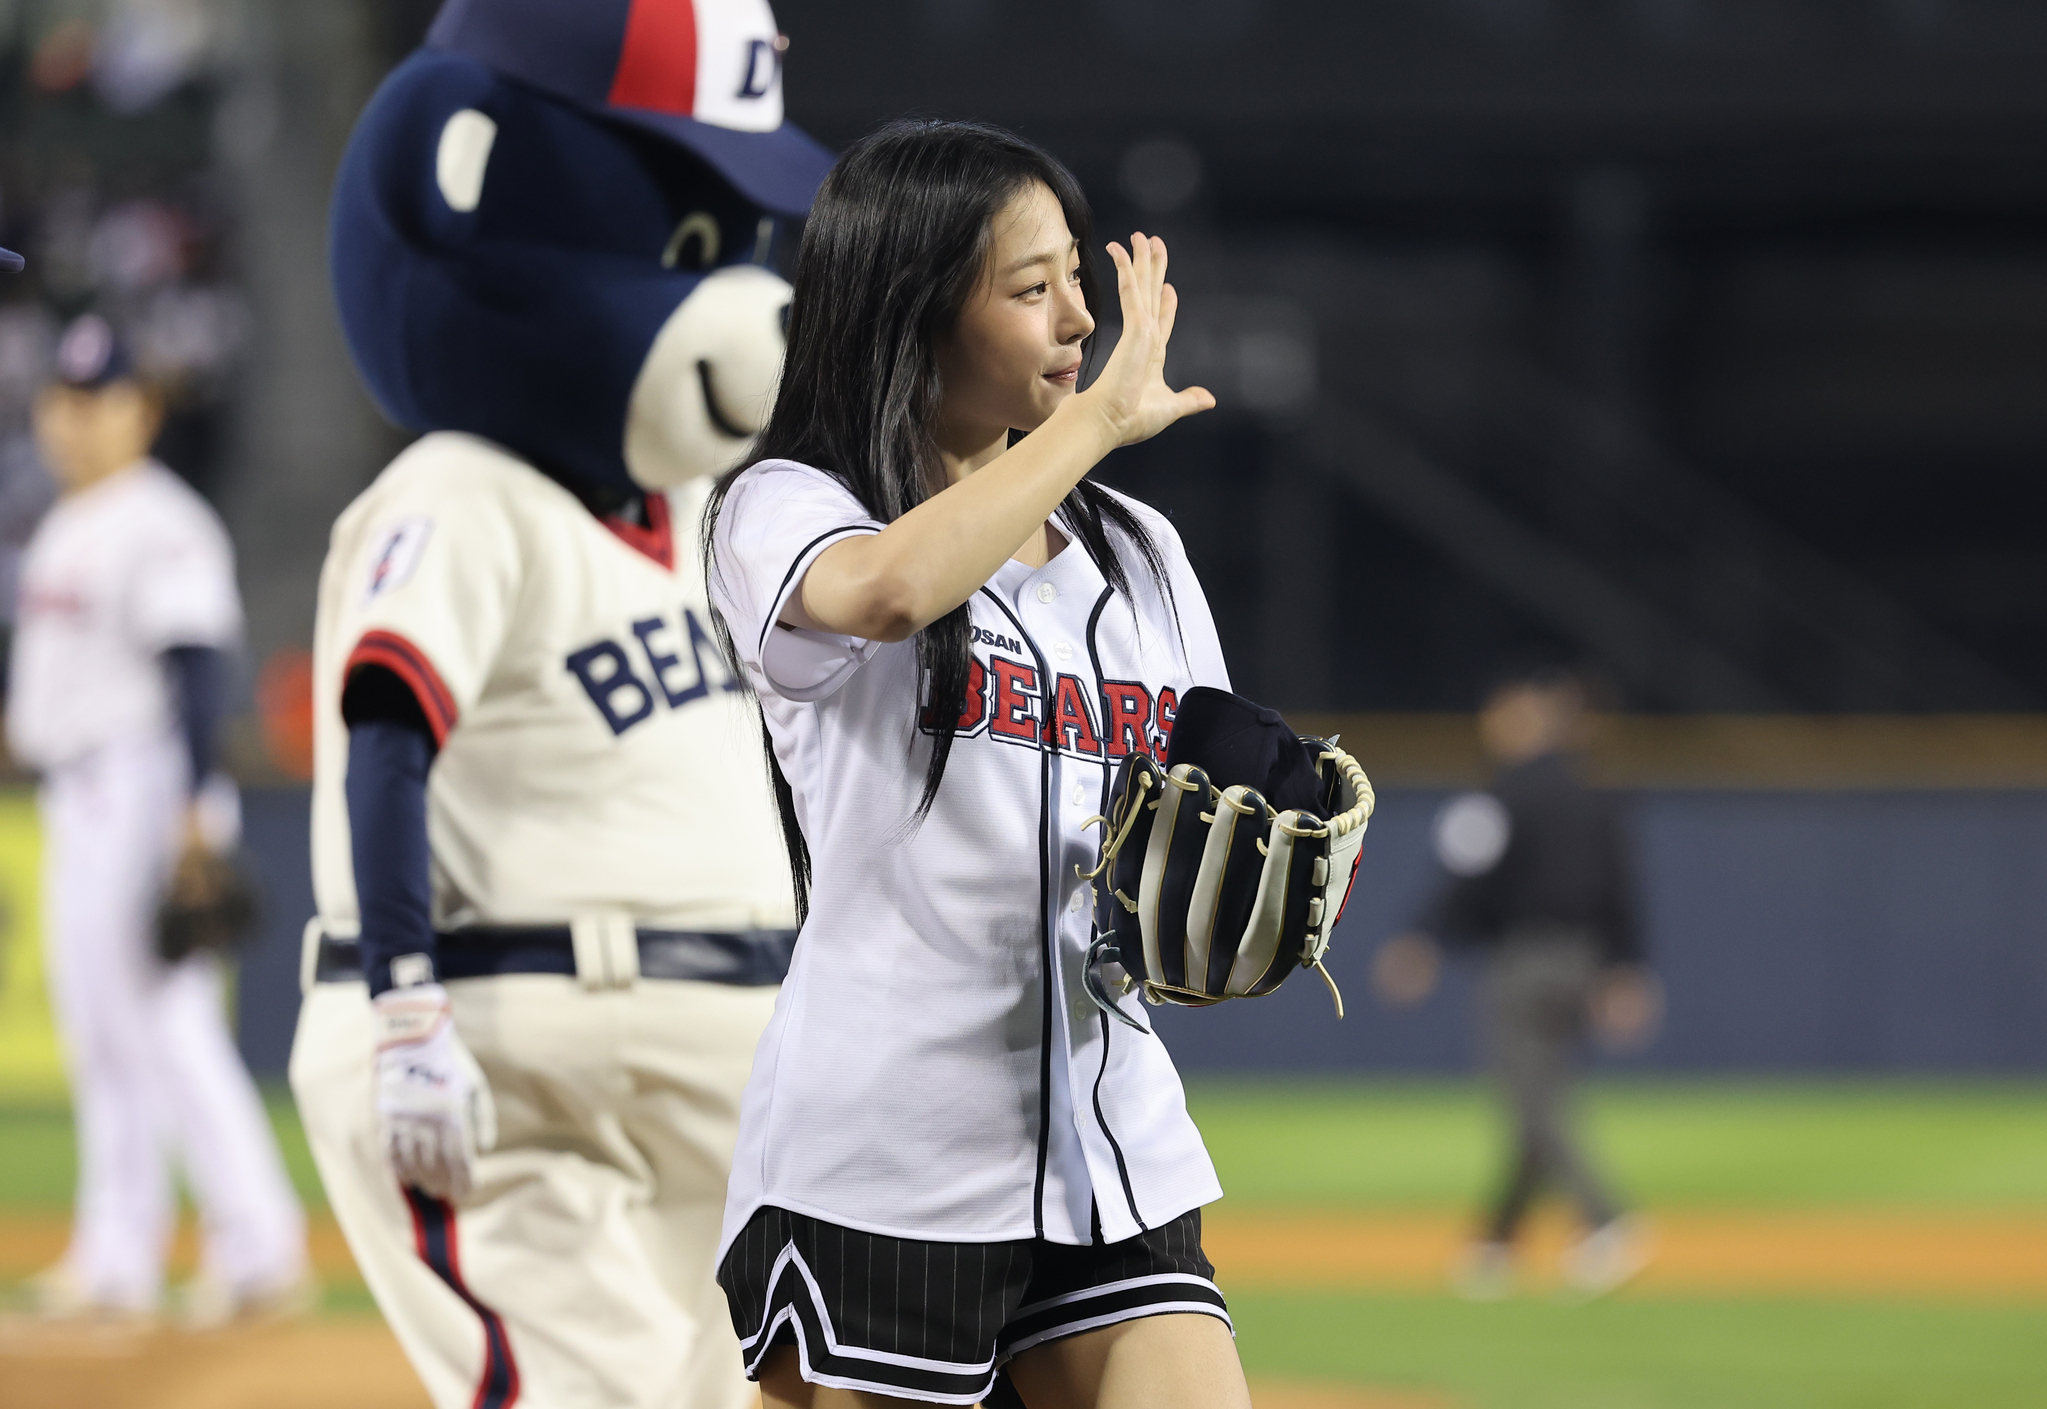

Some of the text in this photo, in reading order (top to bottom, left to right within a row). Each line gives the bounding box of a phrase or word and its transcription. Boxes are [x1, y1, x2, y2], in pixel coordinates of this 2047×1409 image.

[566, 604, 748, 736] BEA
[970, 625, 1022, 655] OSAN
[919, 654, 1178, 767] BEARS
